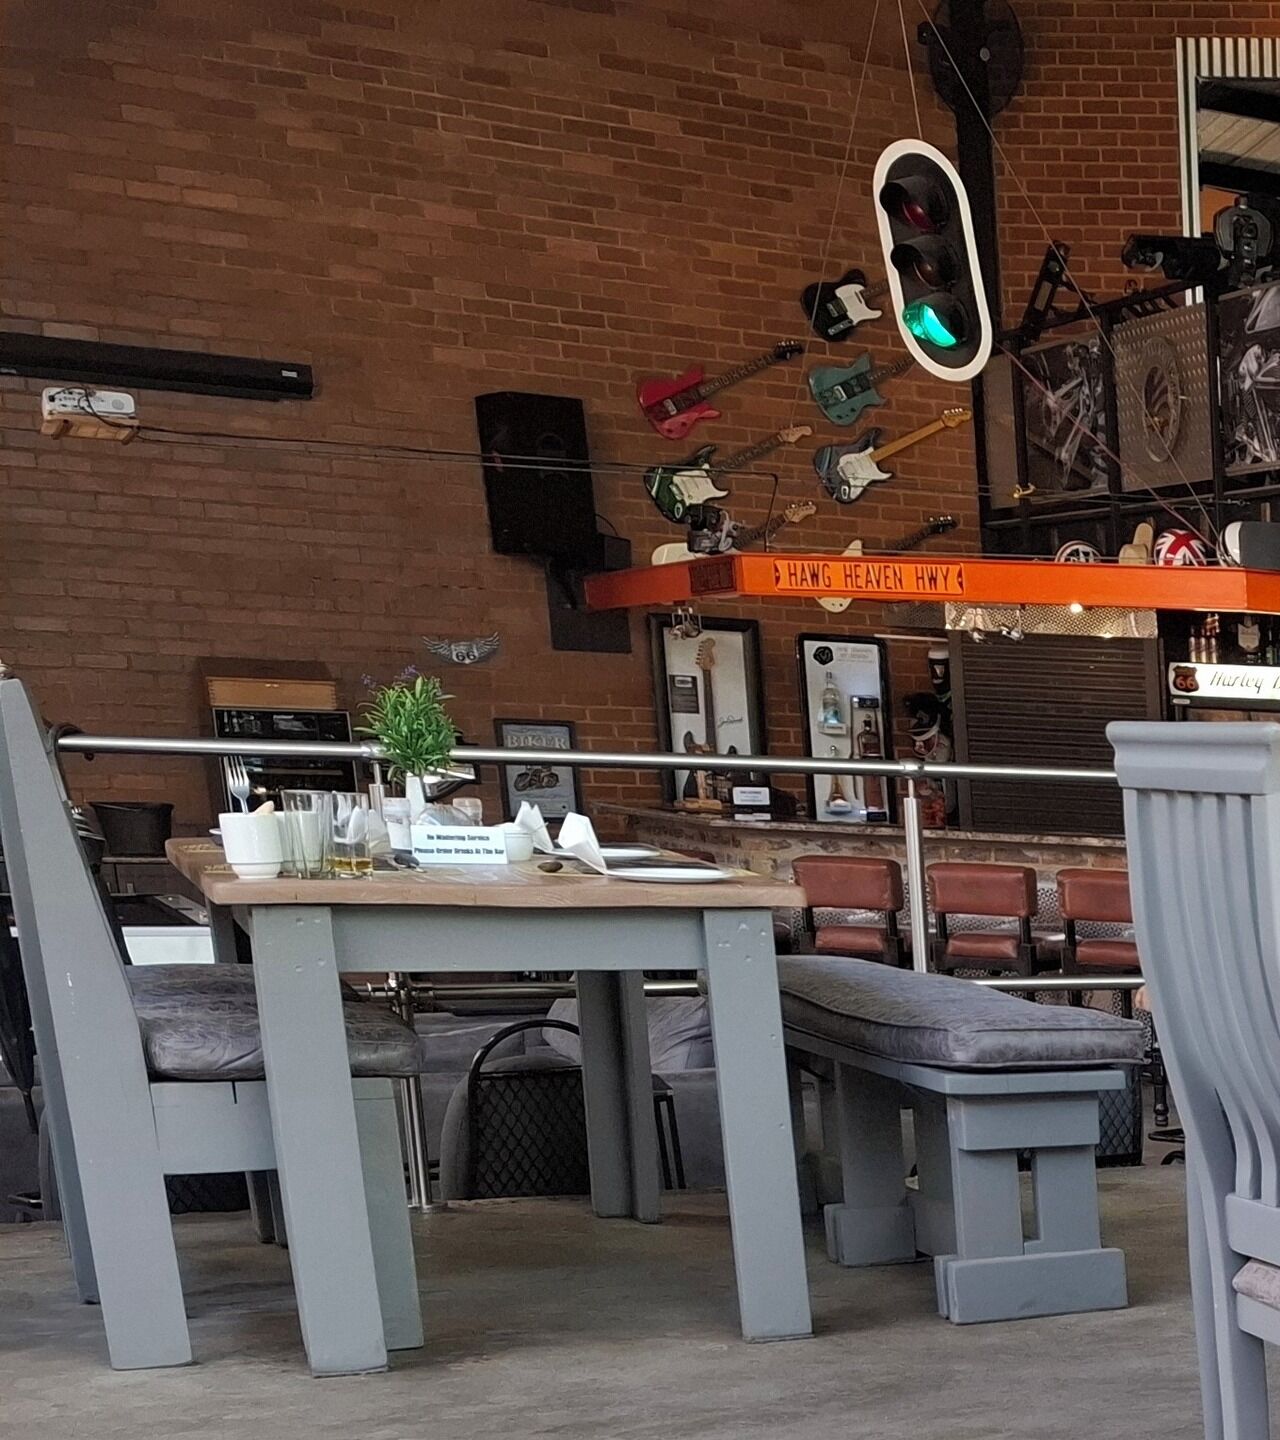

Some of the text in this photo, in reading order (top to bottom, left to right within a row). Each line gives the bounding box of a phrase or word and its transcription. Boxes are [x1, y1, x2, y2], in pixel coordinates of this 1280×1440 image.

[788, 562, 950, 591] HAWG HEAVEN HWY
[456, 651, 477, 661] 66
[1177, 677, 1196, 689] 66
[1210, 672, 1264, 694] Harley
